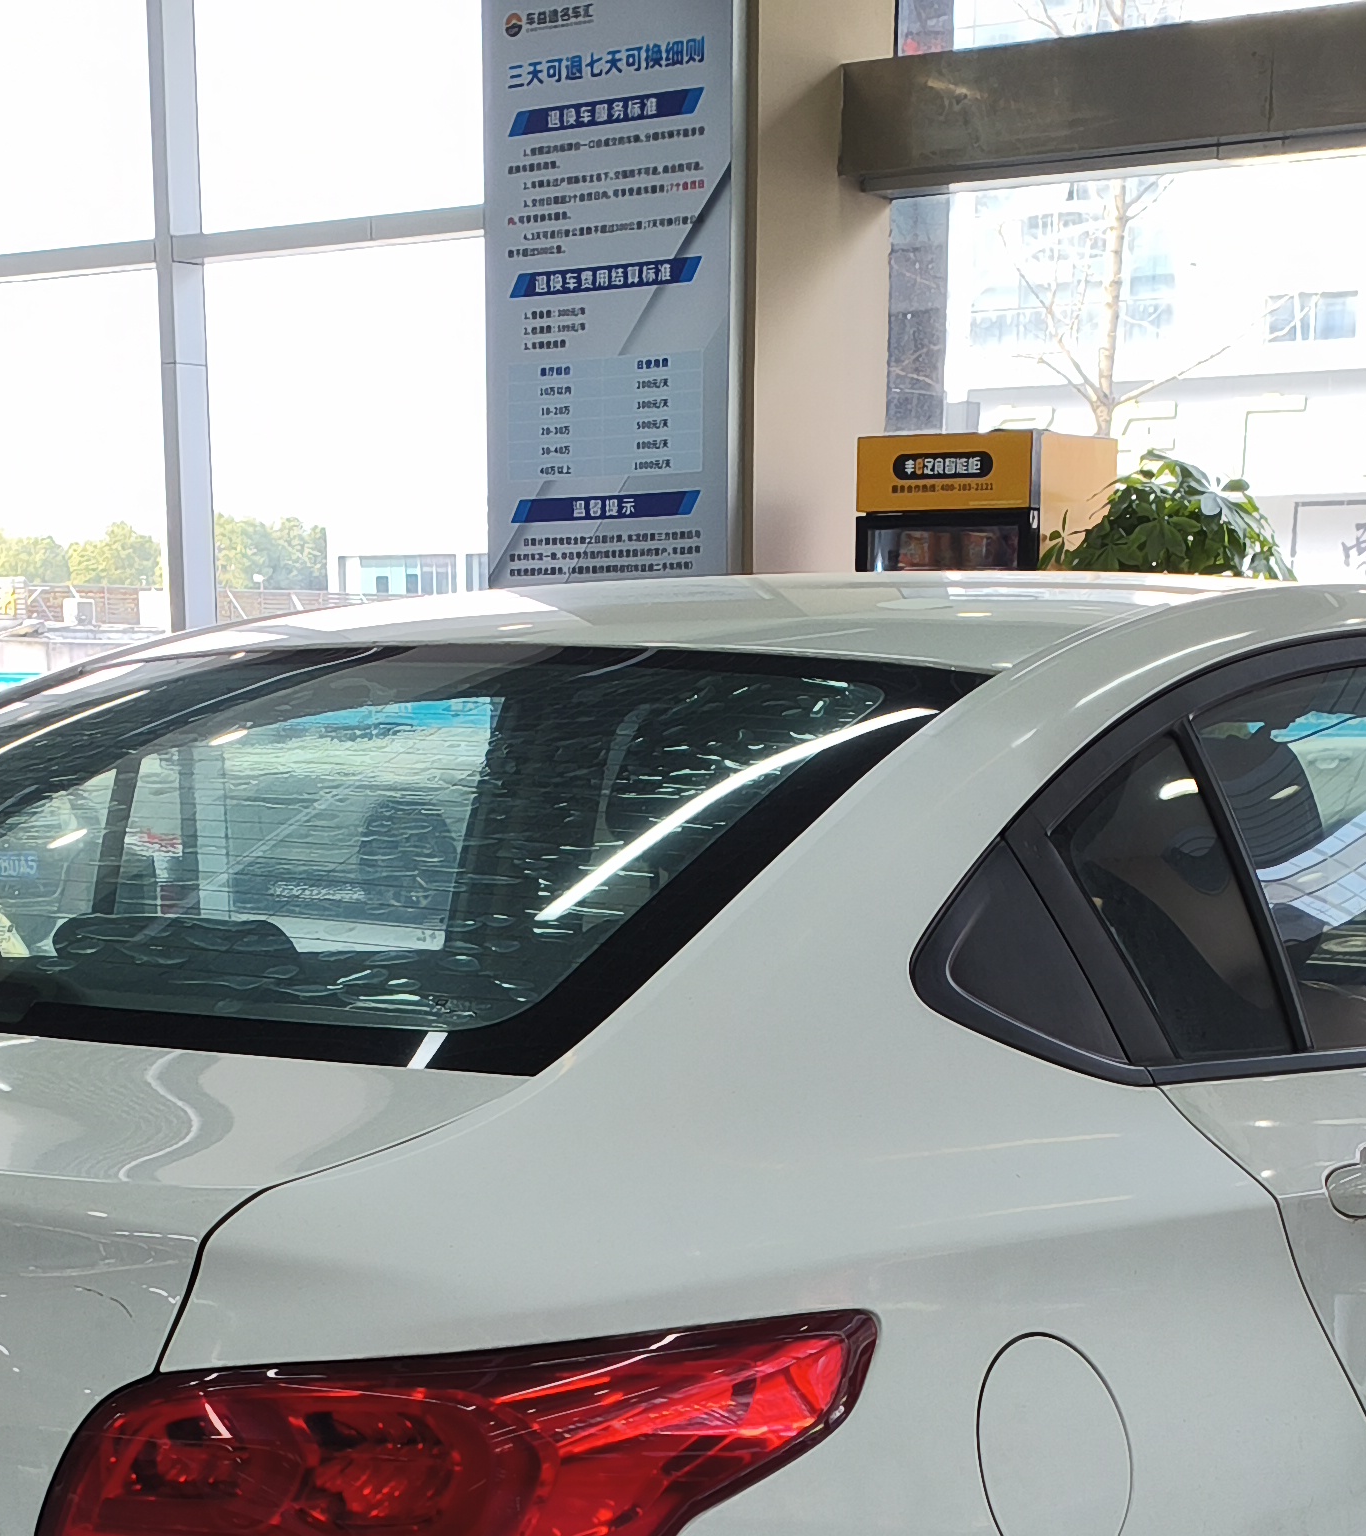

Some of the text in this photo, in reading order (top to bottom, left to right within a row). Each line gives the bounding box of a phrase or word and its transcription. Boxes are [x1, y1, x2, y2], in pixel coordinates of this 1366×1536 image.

[508, 36, 705, 89] 三天可退七天可换细则
[547, 98, 657, 128] 退换车服务标准
[573, 499, 635, 517] 温馨提示
